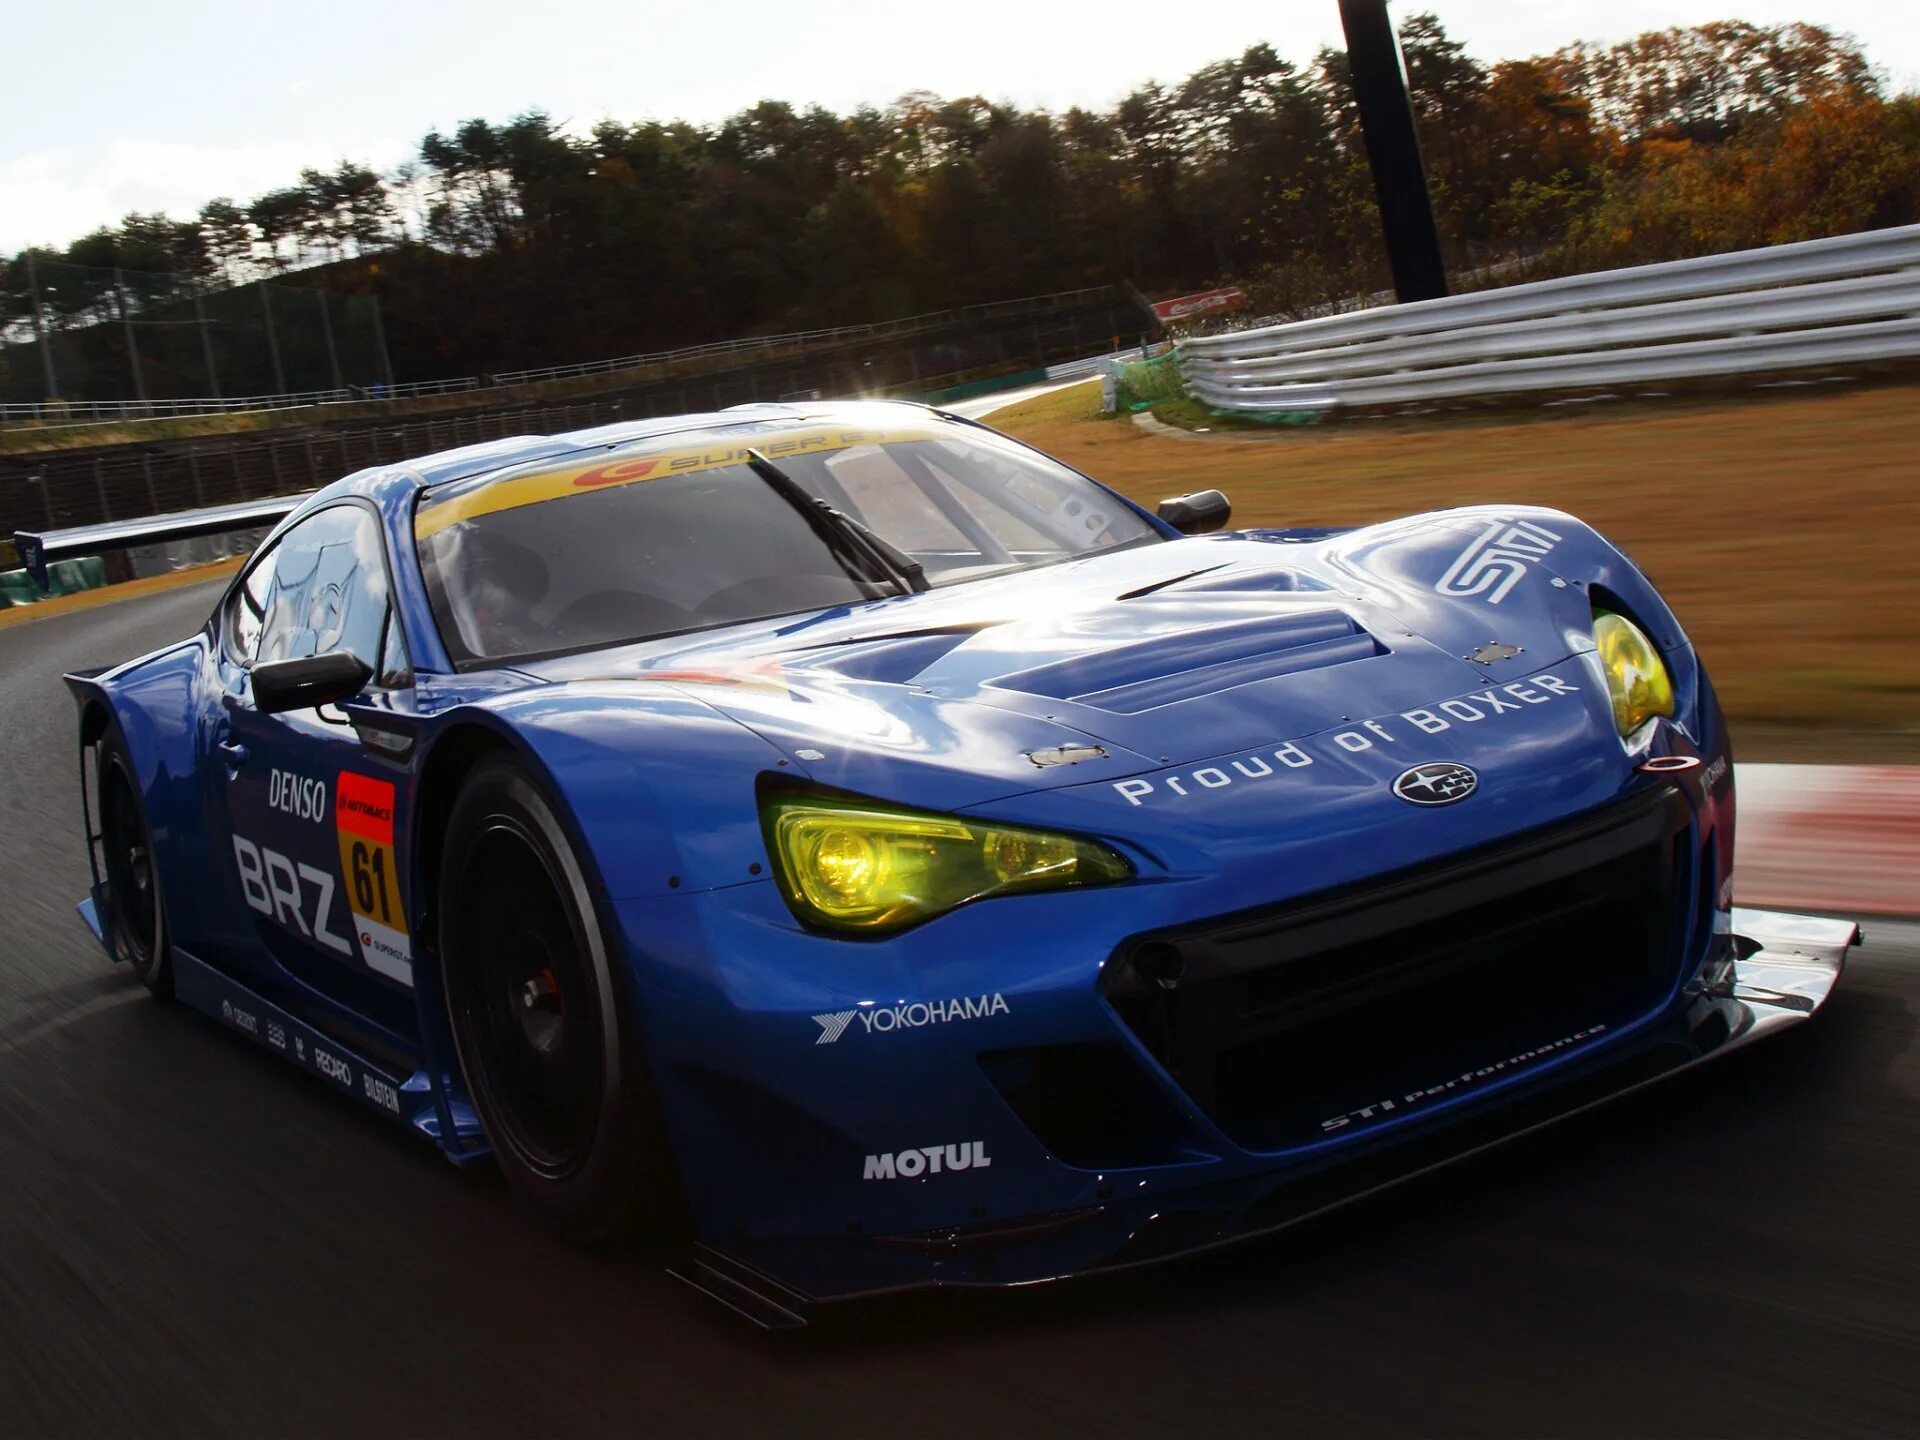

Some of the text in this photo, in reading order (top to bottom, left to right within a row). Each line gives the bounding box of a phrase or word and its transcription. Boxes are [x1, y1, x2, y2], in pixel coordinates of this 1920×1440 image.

[1112, 673, 1581, 807] Proud of BOXER
[269, 768, 326, 823] DENSO
[232, 833, 353, 957] BRZ
[352, 841, 391, 923] 61
[859, 992, 1010, 1033] YOKOHAMA
[314, 1047, 352, 1086] RECARO
[363, 1073, 400, 1114] BILSTEIN
[1321, 1024, 1606, 1132] STI Performance
[863, 1141, 991, 1180] MOTUL
